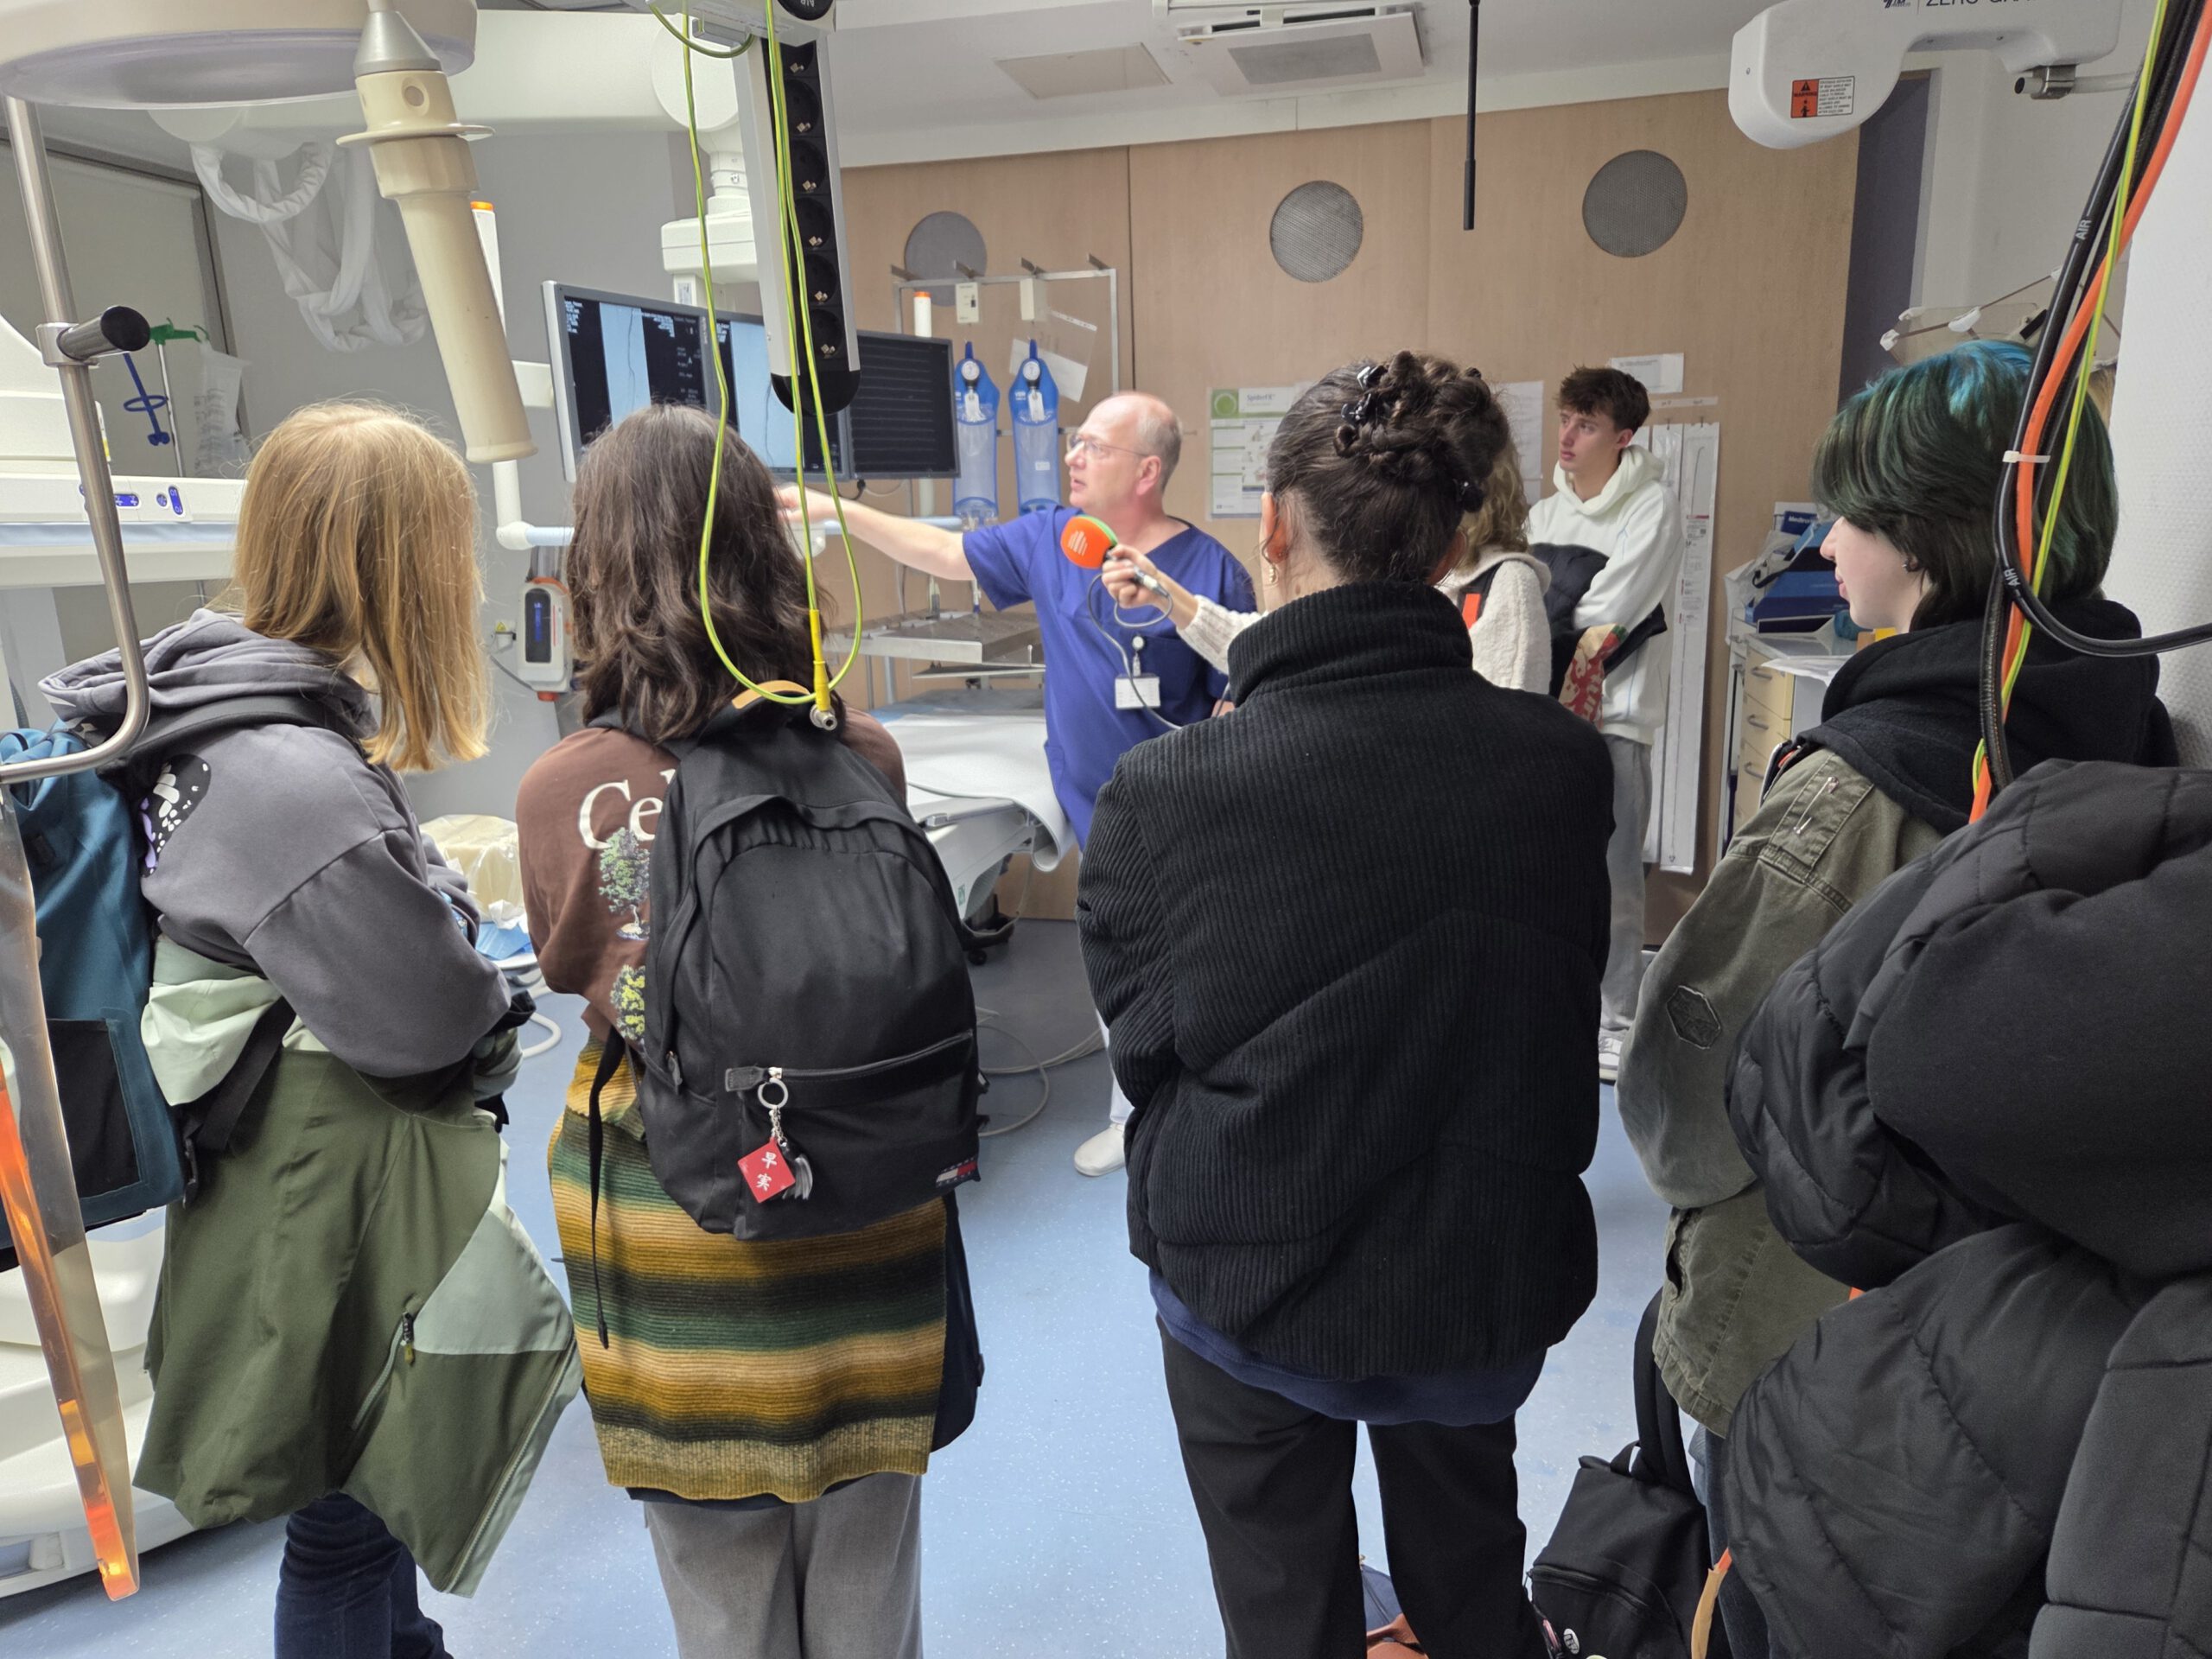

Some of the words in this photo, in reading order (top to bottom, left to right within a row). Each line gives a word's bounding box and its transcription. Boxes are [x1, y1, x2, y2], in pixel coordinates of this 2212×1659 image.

[2075, 219, 2092, 240] AIR
[2003, 568, 2021, 587] AIR
[579, 768, 676, 849] Ce
